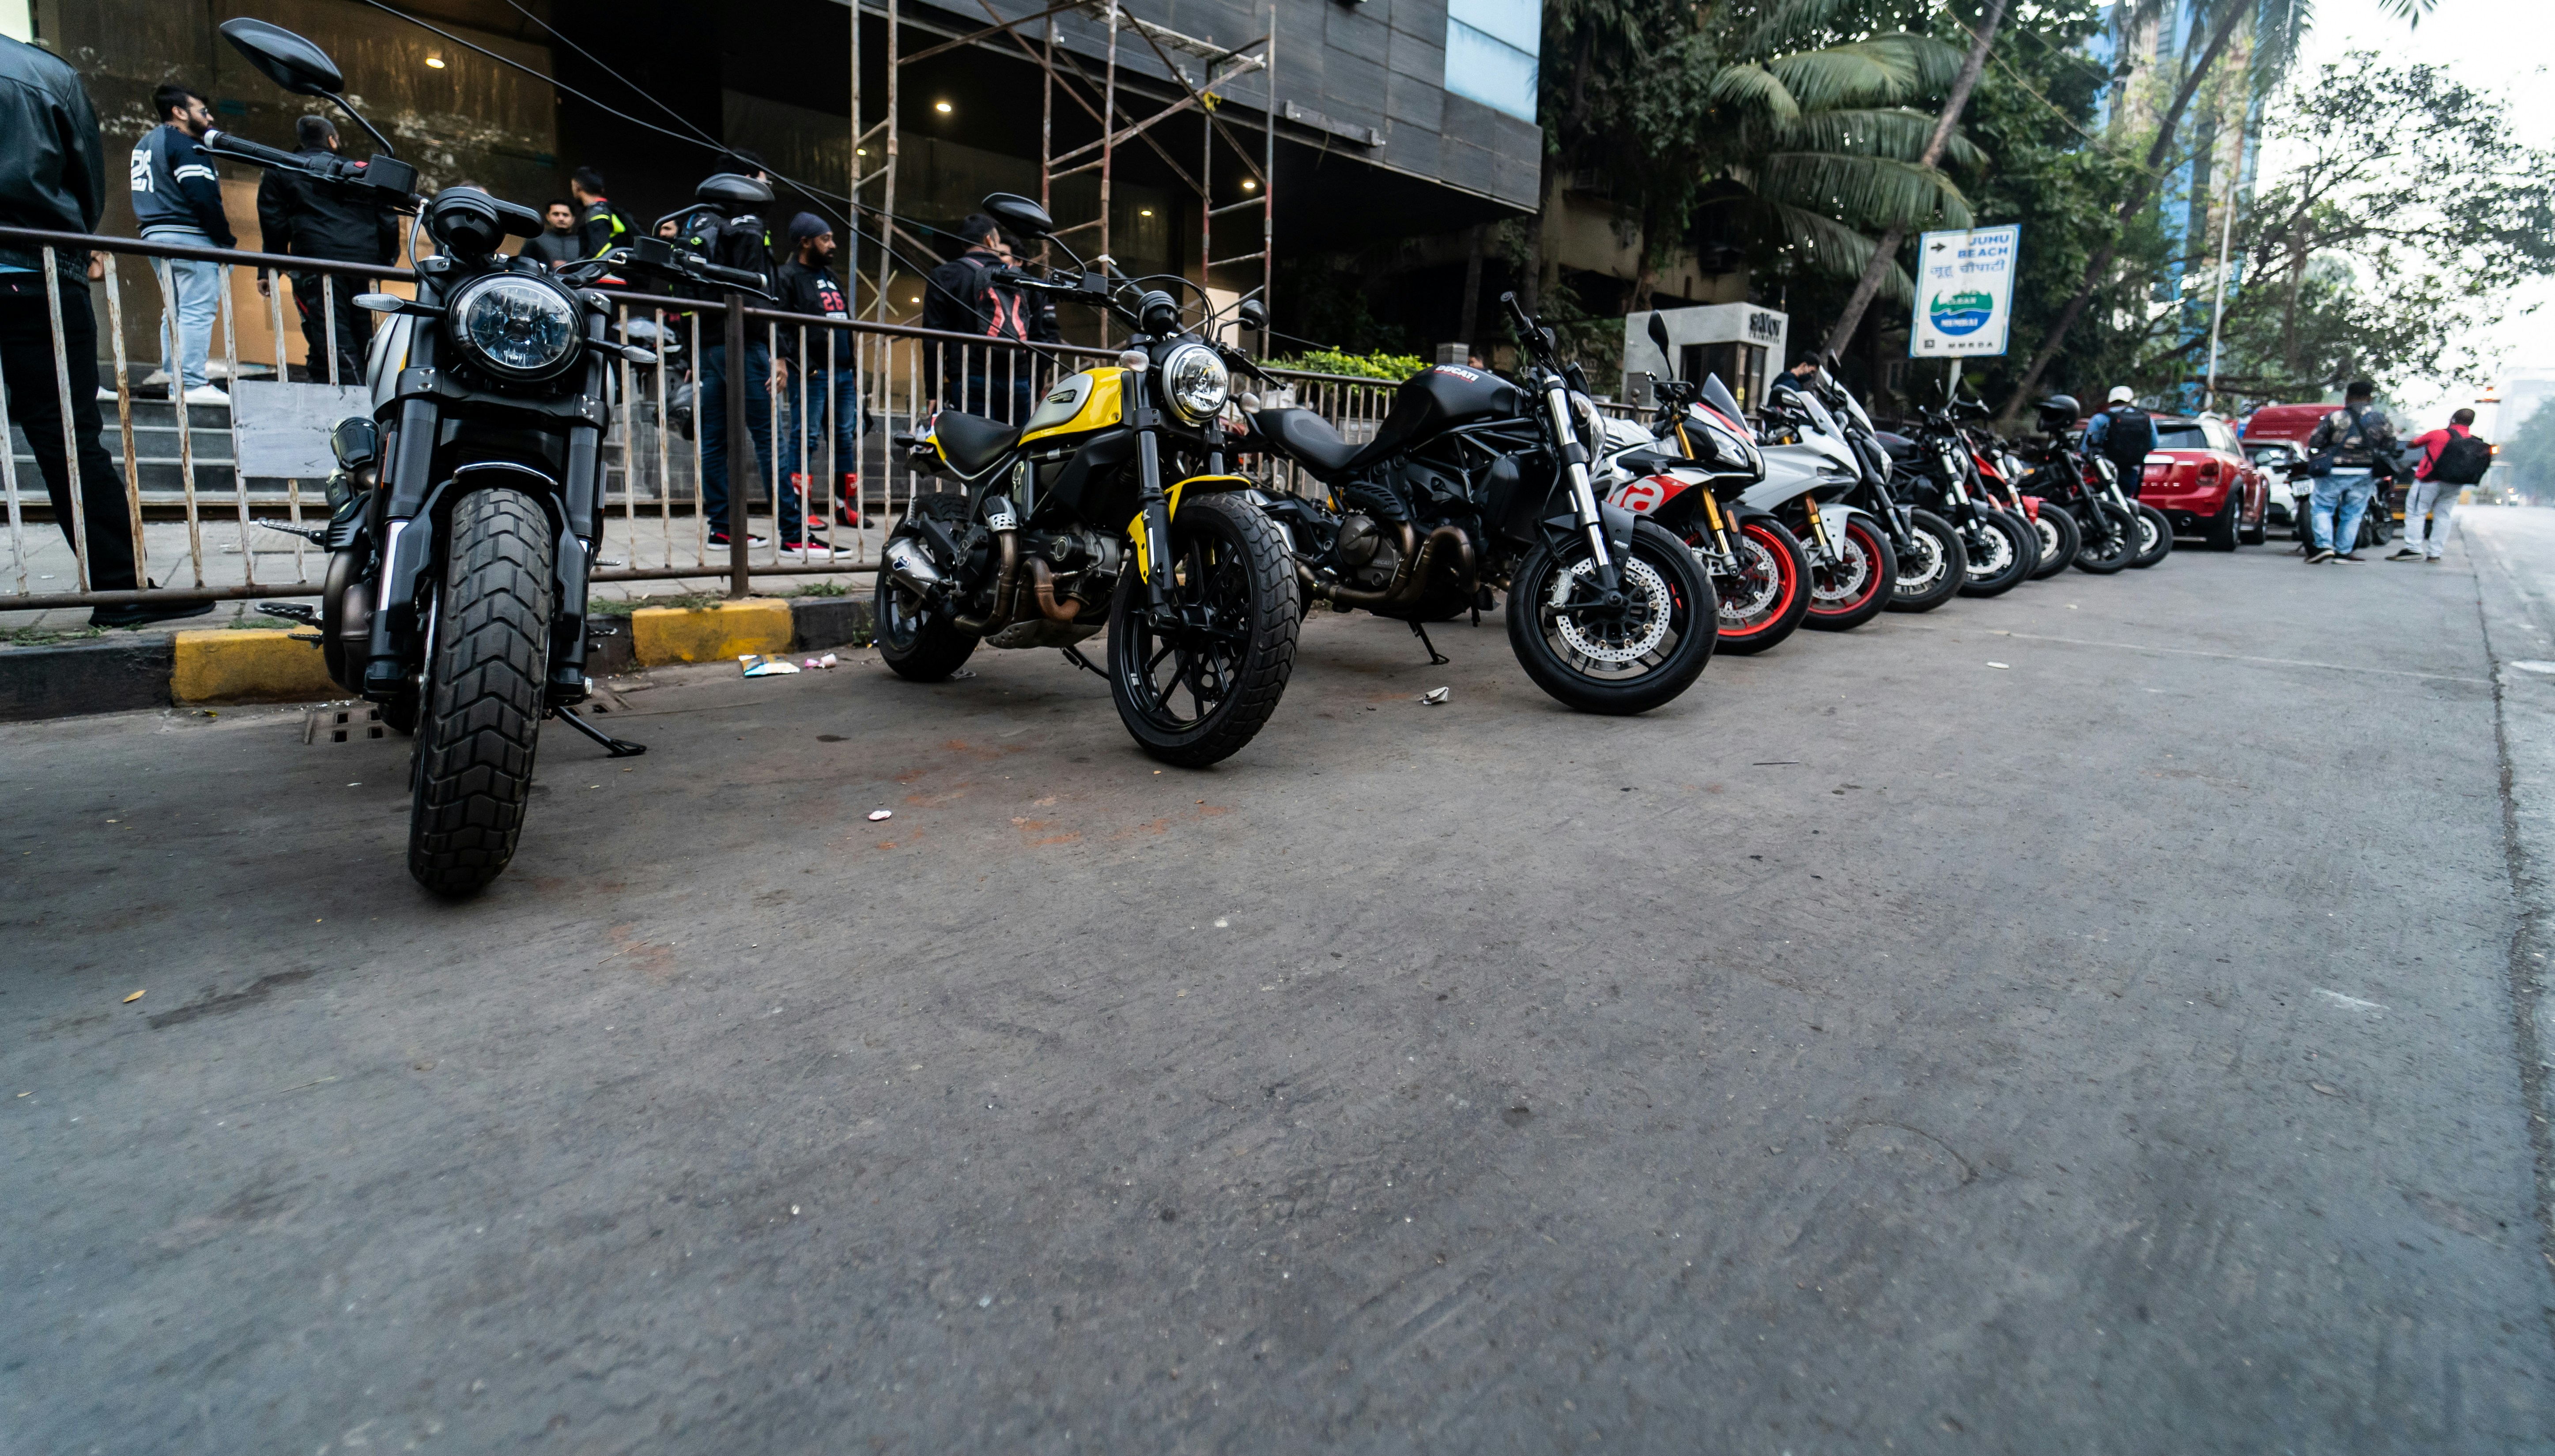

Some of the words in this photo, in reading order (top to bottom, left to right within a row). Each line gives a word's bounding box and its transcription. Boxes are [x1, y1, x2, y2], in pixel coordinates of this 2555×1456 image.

[1969, 235, 2009, 246] JUHU
[1958, 247, 2008, 258] BEACH
[820, 291, 845, 311] 26
[1435, 365, 1479, 381] DUCATI
